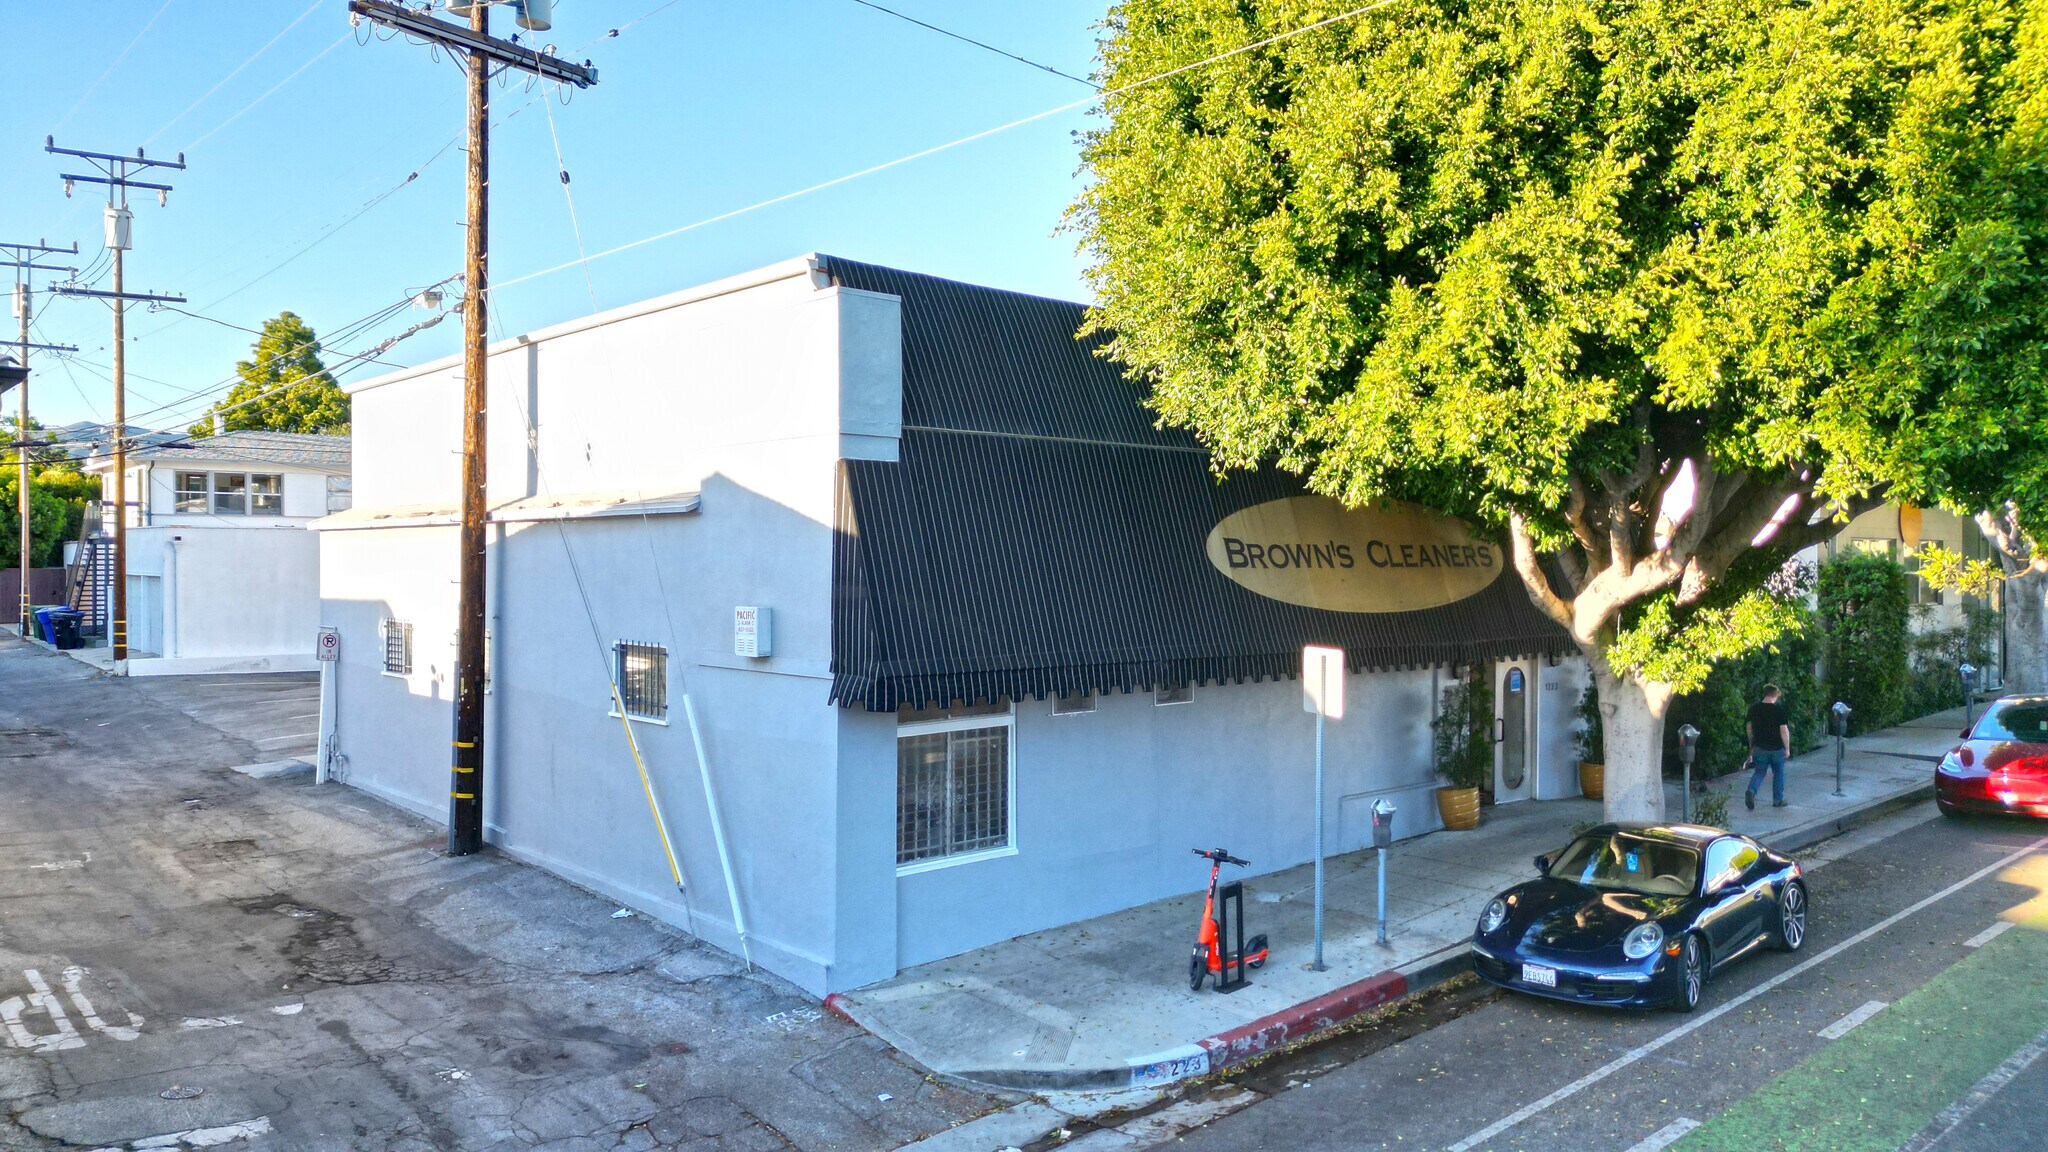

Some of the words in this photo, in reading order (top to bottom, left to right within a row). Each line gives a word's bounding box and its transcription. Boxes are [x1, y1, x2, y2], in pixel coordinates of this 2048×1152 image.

[1223, 537, 1354, 569] BROWN'S
[1366, 540, 1492, 568] CLEANERS
[736, 610, 755, 620] PACIFIC
